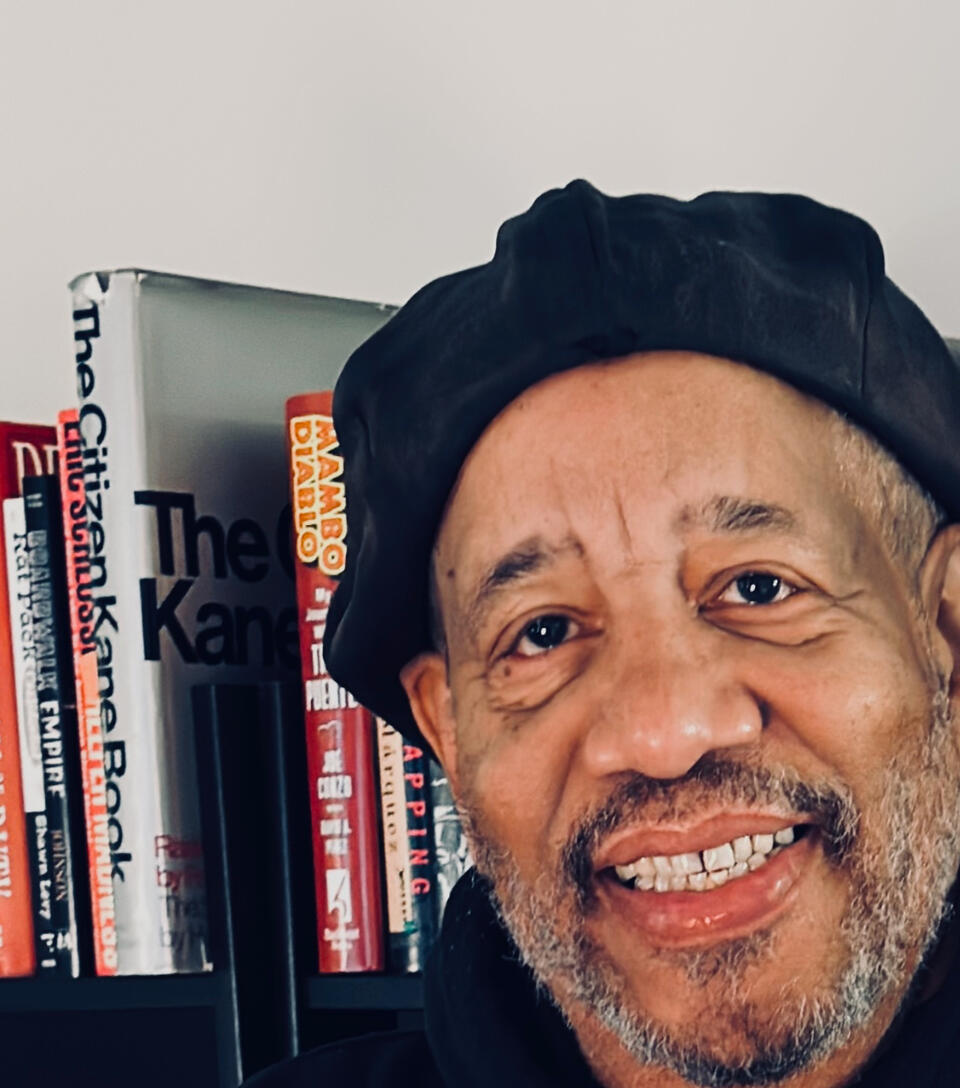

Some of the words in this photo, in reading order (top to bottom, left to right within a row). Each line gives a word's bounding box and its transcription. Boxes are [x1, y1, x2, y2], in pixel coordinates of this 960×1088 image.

[73, 304, 101, 399] The
[80, 403, 110, 588] Citizen
[134, 490, 269, 584] The
[290, 417, 320, 564] DIABLO
[314, 415, 348, 576] MAMBO
[27, 530, 60, 691] BOARDWALK
[93, 596, 119, 734] Kane
[140, 577, 300, 667] Kane
[40, 700, 67, 799] EMPIRE
[35, 814, 49, 875] Shawn
[51, 829, 69, 901] JOHNSON
[104, 741, 132, 883] Book
[403, 745, 431, 895] APPING
[39, 879, 52, 920] Levy
